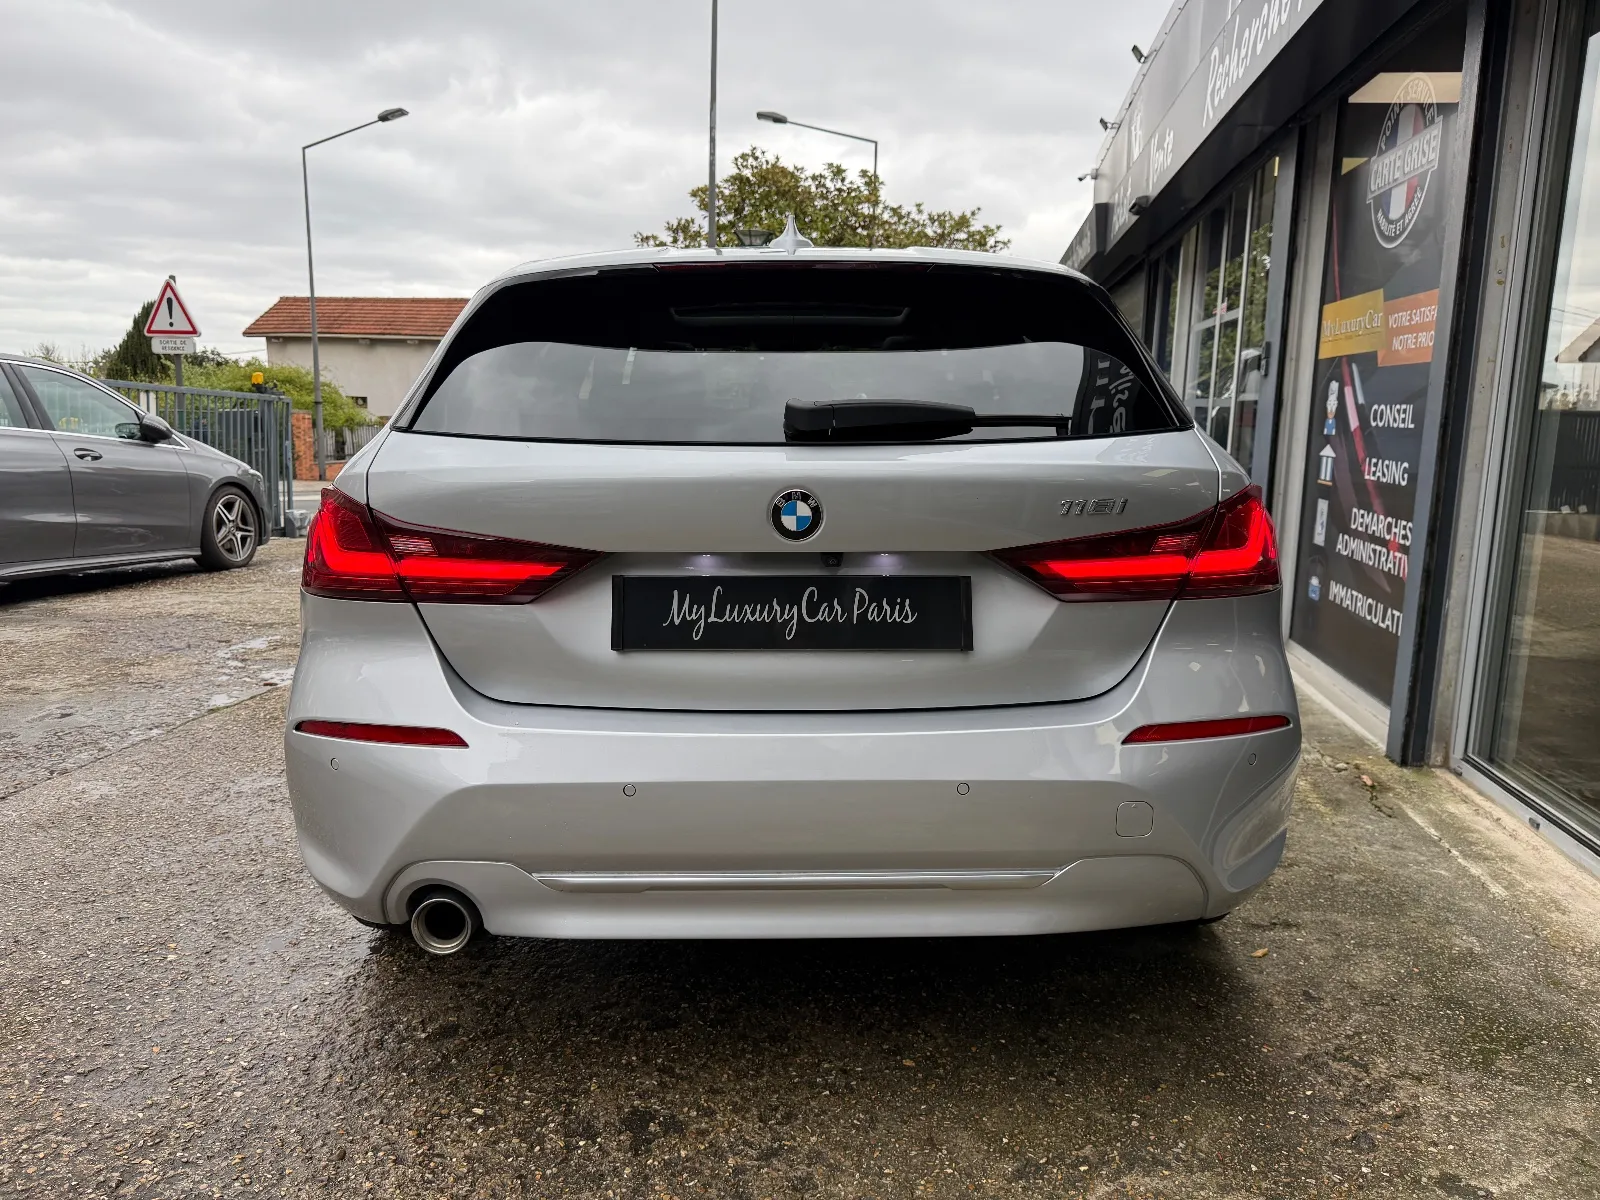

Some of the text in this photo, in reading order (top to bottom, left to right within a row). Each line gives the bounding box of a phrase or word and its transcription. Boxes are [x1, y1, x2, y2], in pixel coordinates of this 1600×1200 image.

[1380, 89, 1405, 152] POINT
[1370, 128, 1438, 193] CARTE GRISE
[1396, 219, 1404, 235] ET
[1322, 309, 1383, 337] MyLuxuryCar
[1388, 310, 1411, 329] VOTRE
[1392, 330, 1435, 351] NOTRE PRIO
[1370, 404, 1415, 429] CONSEIL
[1364, 457, 1409, 486] LEASING
[774, 491, 818, 508] BMW
[1350, 507, 1413, 546] DEMARCHES
[853, 588, 917, 624] Paris
[1329, 580, 1403, 637] IMMATRICULATI
